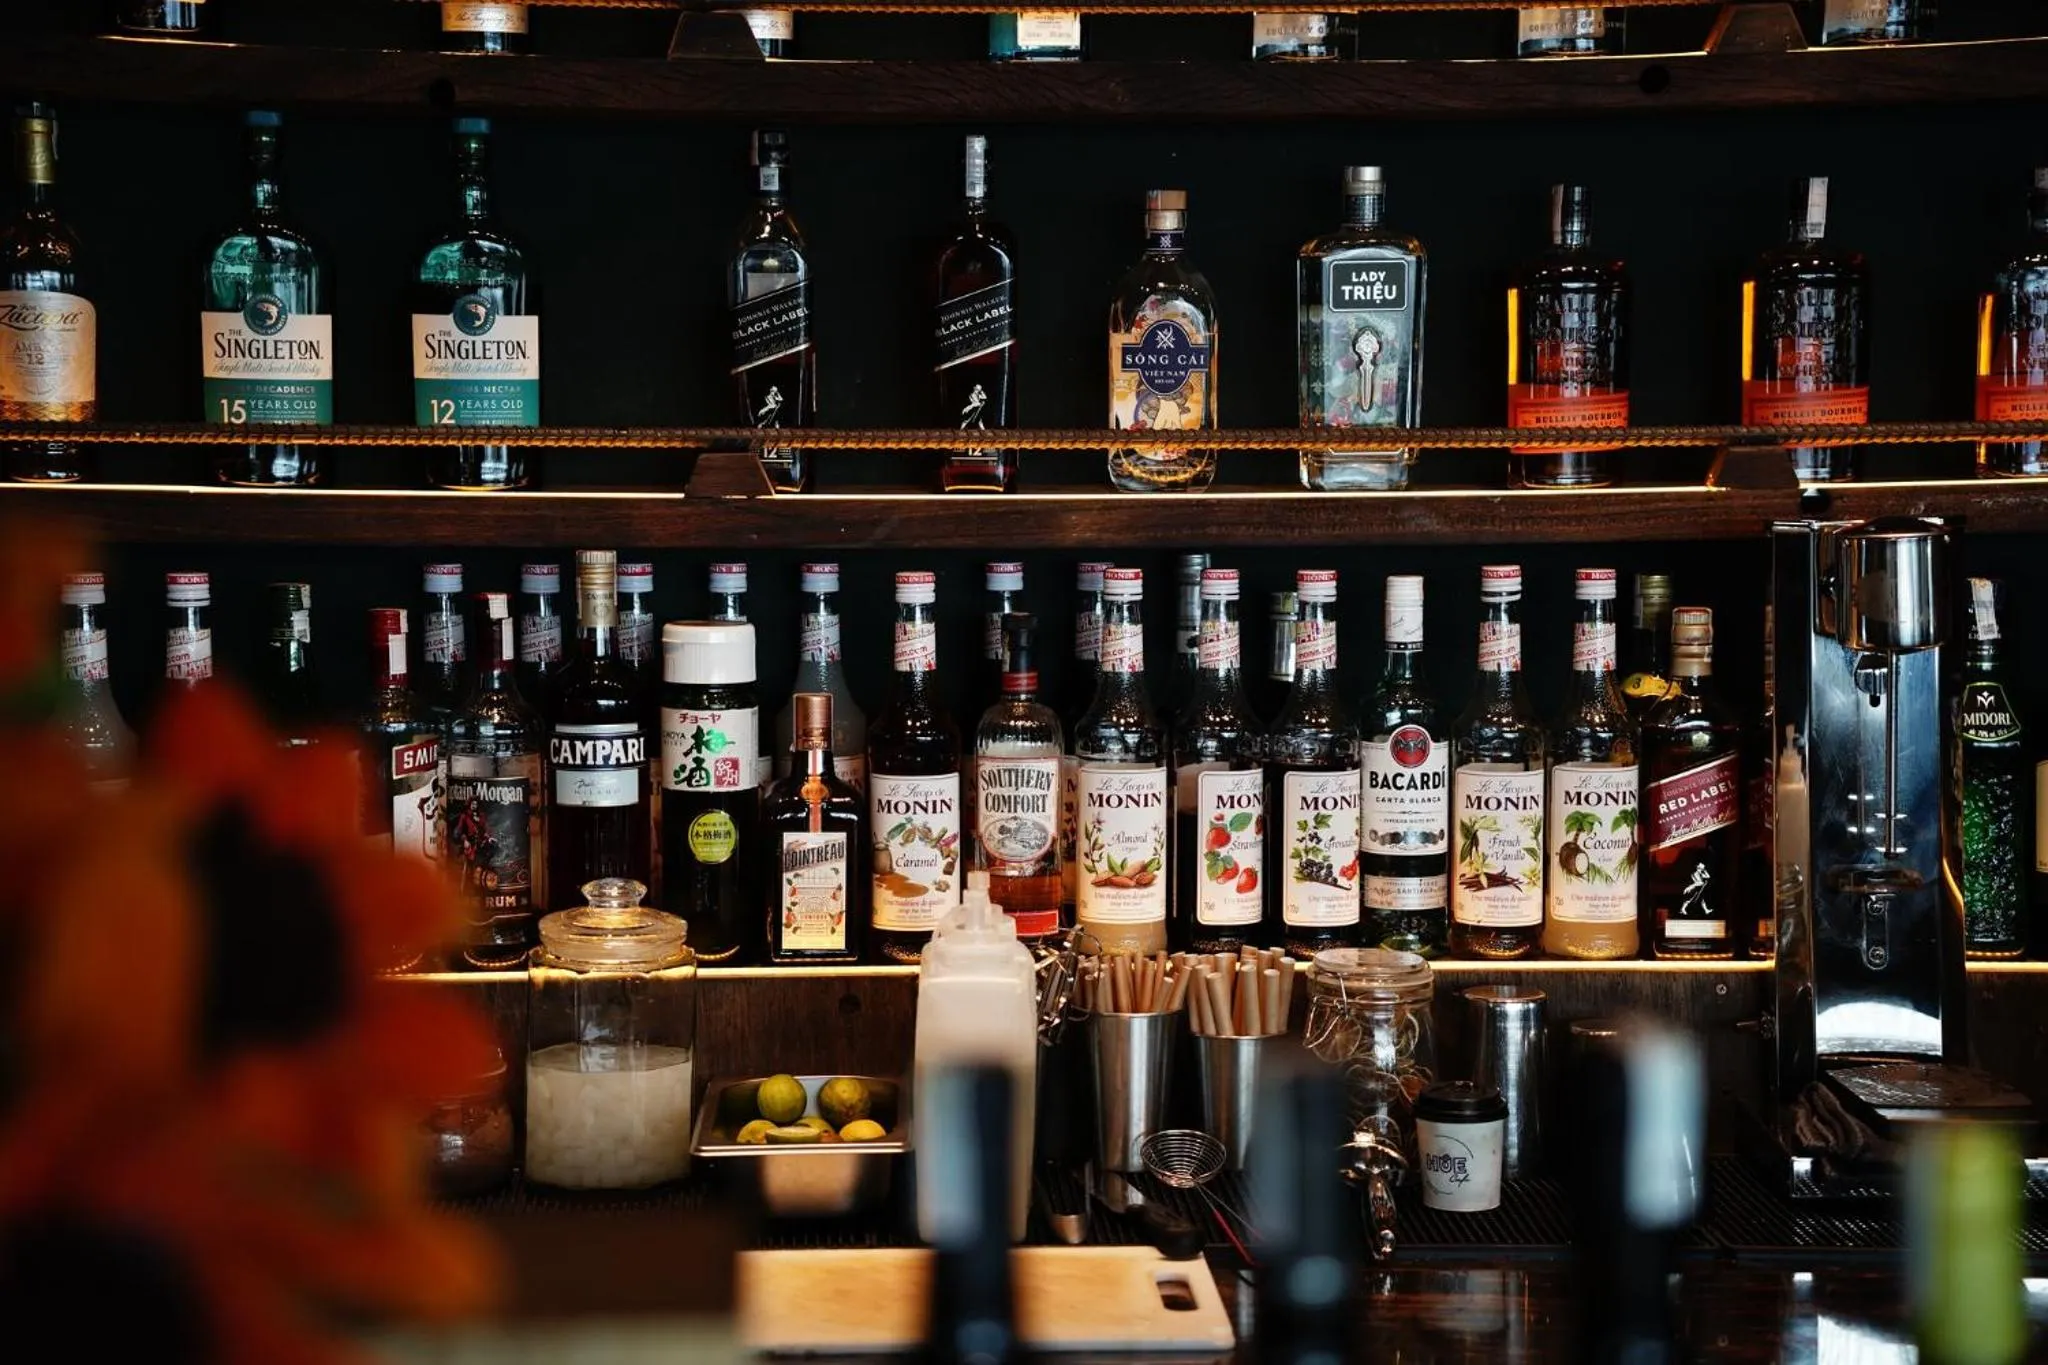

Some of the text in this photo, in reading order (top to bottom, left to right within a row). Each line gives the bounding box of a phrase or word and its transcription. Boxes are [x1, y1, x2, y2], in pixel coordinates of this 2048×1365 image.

[1351, 271, 1387, 282] LADY
[731, 306, 810, 340] BLACK LABEL
[934, 304, 1014, 338] BLACK LABEL
[219, 398, 247, 424] 15
[249, 400, 291, 409] YEARS
[293, 400, 318, 409] OLD
[431, 398, 456, 424] 12
[458, 399, 497, 409] YEARS
[500, 399, 524, 409] OLD
[679, 712, 721, 723] チョーヤ
[1963, 711, 2011, 727] MIDORI
[550, 737, 646, 765] CAMPARI
[980, 768, 1055, 791] SOUTHERN
[1369, 765, 1446, 791] BACARDÍ
[472, 781, 523, 805] Morgan
[1087, 792, 1162, 808] MONIN
[1409, 796, 1442, 804] BLANCA
[1563, 789, 1637, 806] MONIN
[1658, 780, 1736, 814] RED LABEL
[877, 797, 952, 815] MONIN
[984, 792, 1048, 813] COMFORT
[1465, 794, 1541, 811] MONIN
[1107, 831, 1149, 846] Almond
[1486, 834, 1520, 849] French
[784, 841, 845, 871] COINTREAU
[895, 853, 938, 868] Caramel
[485, 895, 517, 908] RUM
